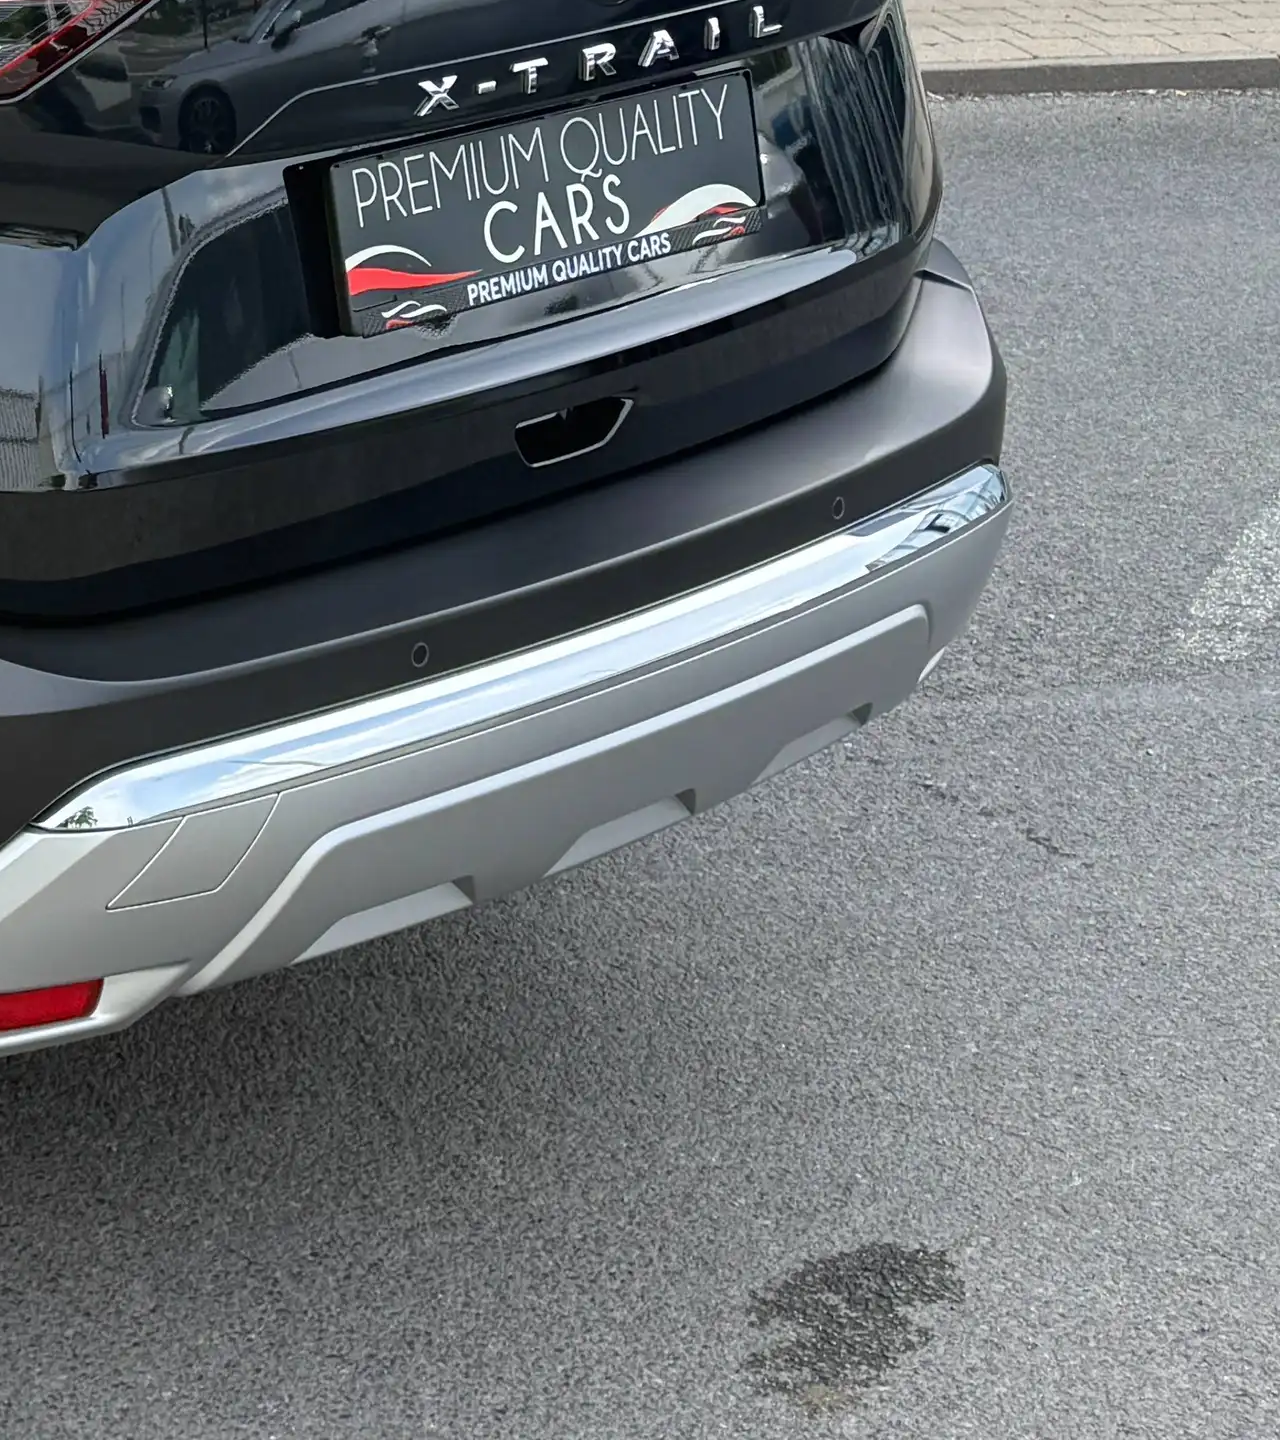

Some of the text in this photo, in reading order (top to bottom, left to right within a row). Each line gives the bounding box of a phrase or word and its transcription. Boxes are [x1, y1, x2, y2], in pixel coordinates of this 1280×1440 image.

[414, 5, 783, 117] X-TRAIL
[351, 83, 728, 229] PREMIUM QUALITY
[483, 173, 631, 264] CARS
[466, 232, 672, 307] PREMIUM QUALITY CARS
